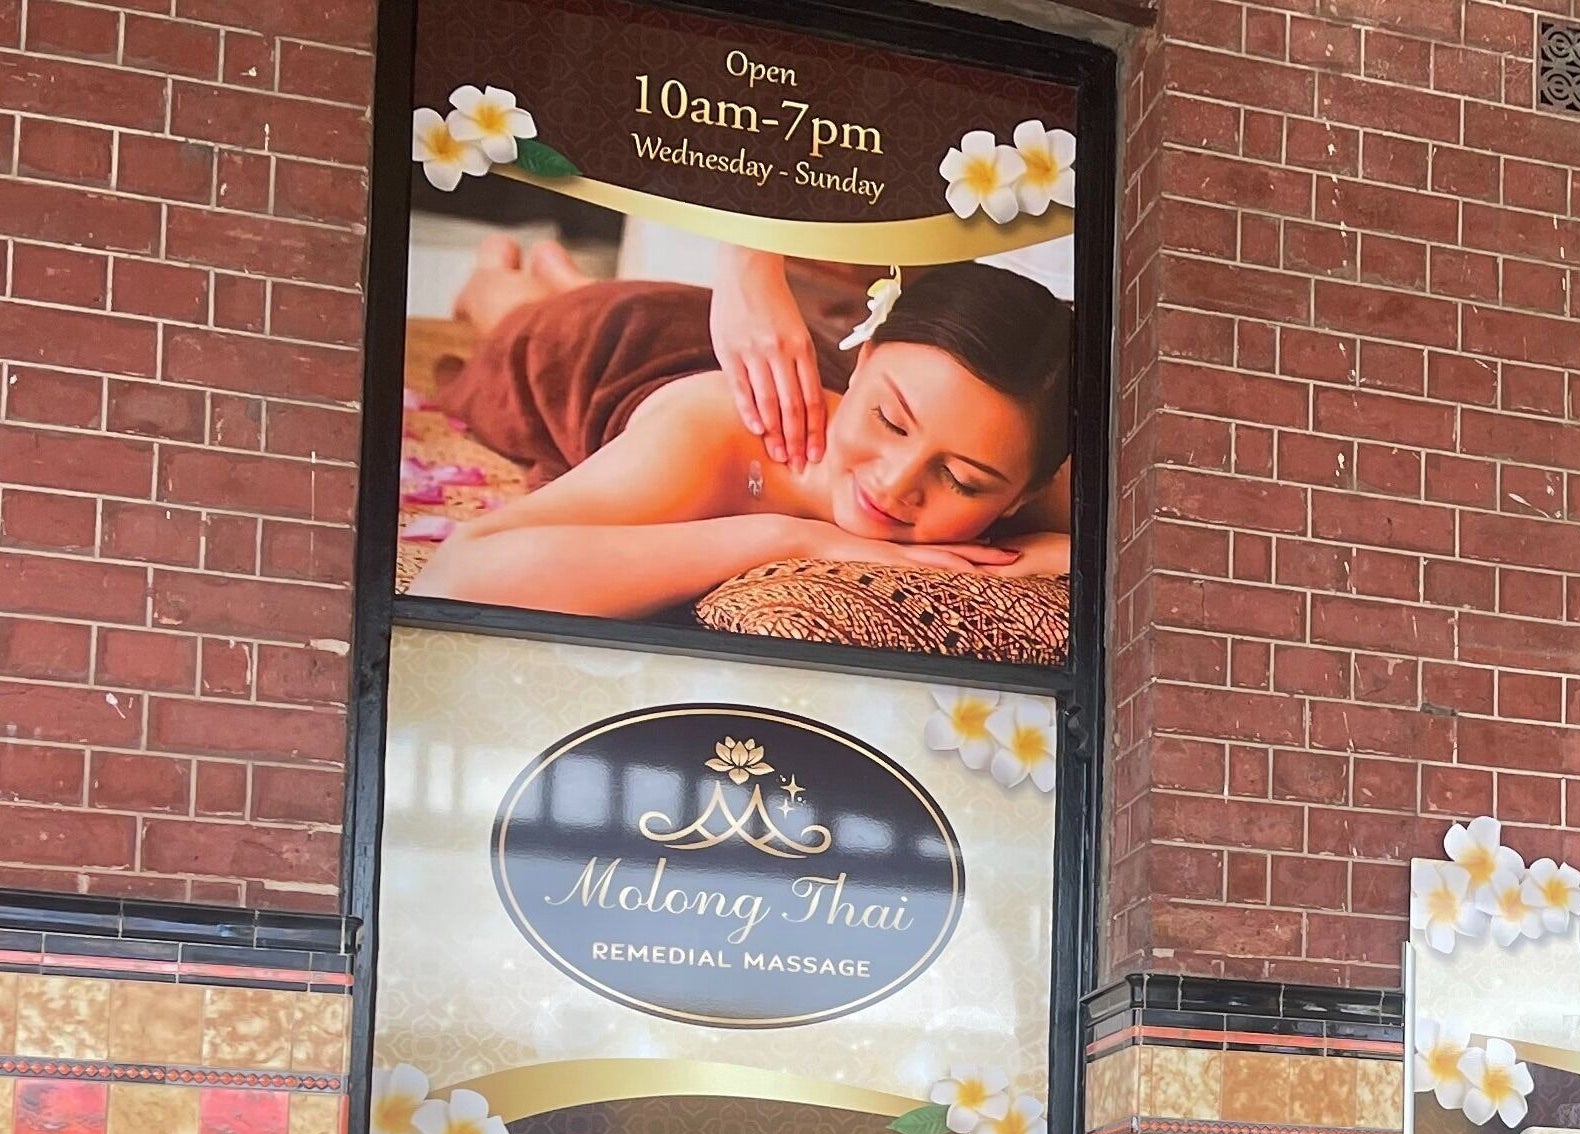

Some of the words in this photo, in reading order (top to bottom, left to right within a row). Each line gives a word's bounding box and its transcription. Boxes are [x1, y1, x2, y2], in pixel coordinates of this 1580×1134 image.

[726, 49, 798, 88] Open
[634, 74, 884, 158] 10am-7pm
[630, 132, 773, 187] Wednesday
[794, 161, 885, 205] Sunday
[544, 856, 771, 945] Molong
[780, 872, 915, 932] Thai
[592, 941, 732, 969] REMEDIAL
[743, 952, 872, 978] MASSAGE
